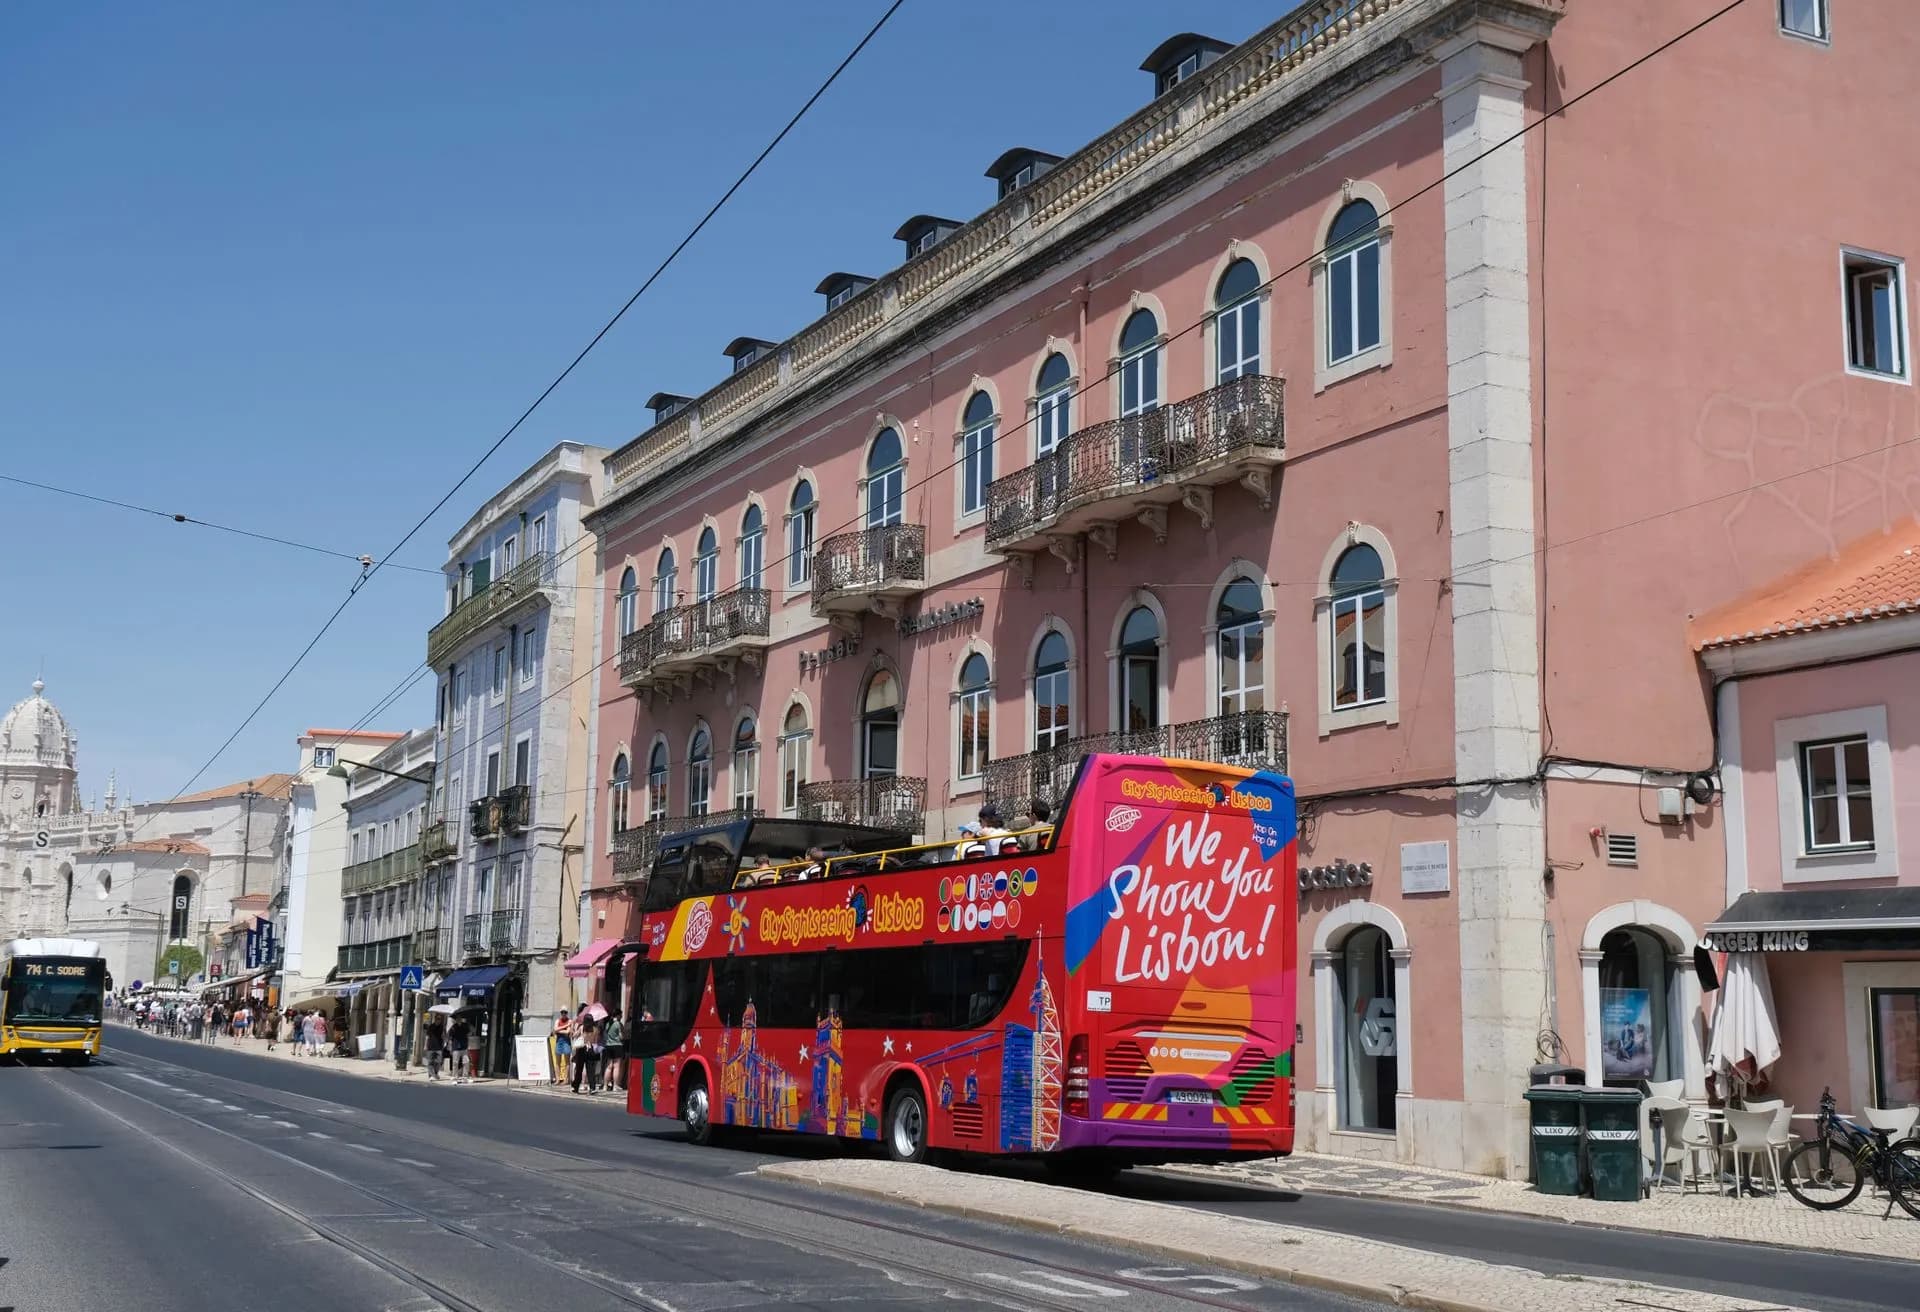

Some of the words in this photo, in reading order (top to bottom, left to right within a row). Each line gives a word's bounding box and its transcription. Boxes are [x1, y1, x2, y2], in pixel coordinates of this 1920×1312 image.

[1231, 790, 1272, 811] Lisboa
[1108, 810, 1139, 828] OFFICIAL
[35, 831, 49, 847] S
[1165, 810, 1222, 868] We
[1268, 825, 1277, 836] On
[1108, 865, 1214, 920] Show
[1206, 847, 1274, 923] You
[177, 897, 185, 908] S
[873, 891, 924, 933] Lisboa
[1116, 905, 1276, 982] Lisbon!
[1762, 931, 1809, 952] KING
[26, 964, 42, 976] 714
[57, 966, 86, 976] SODRE
[1098, 996, 1111, 1006] TP
[1601, 1131, 1622, 1139] LIXO
